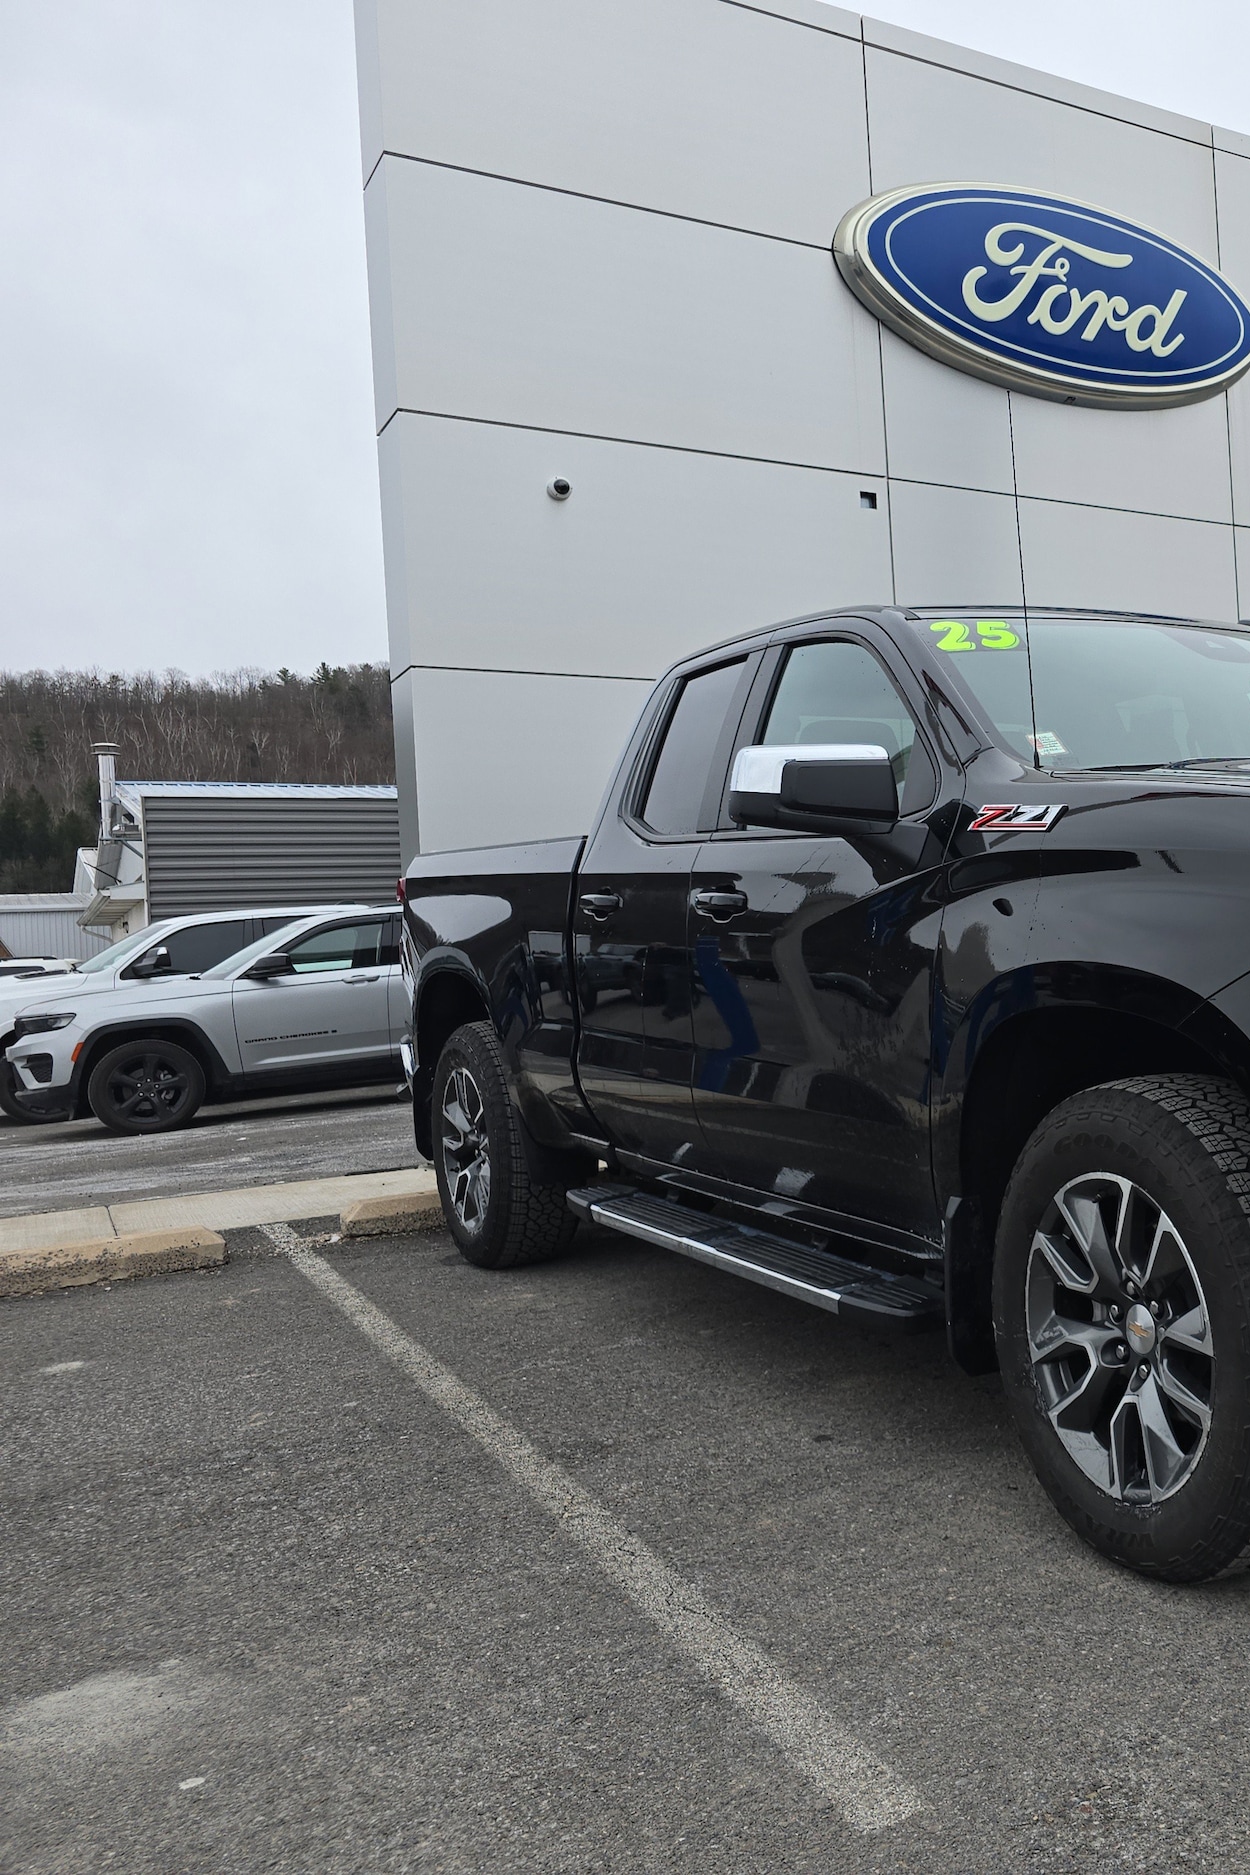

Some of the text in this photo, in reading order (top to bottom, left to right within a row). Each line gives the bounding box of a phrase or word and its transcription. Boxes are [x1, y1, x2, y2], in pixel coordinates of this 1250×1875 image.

[962, 222, 1187, 357] Ford
[930, 621, 1020, 651] 25
[967, 804, 1067, 832] Z71
